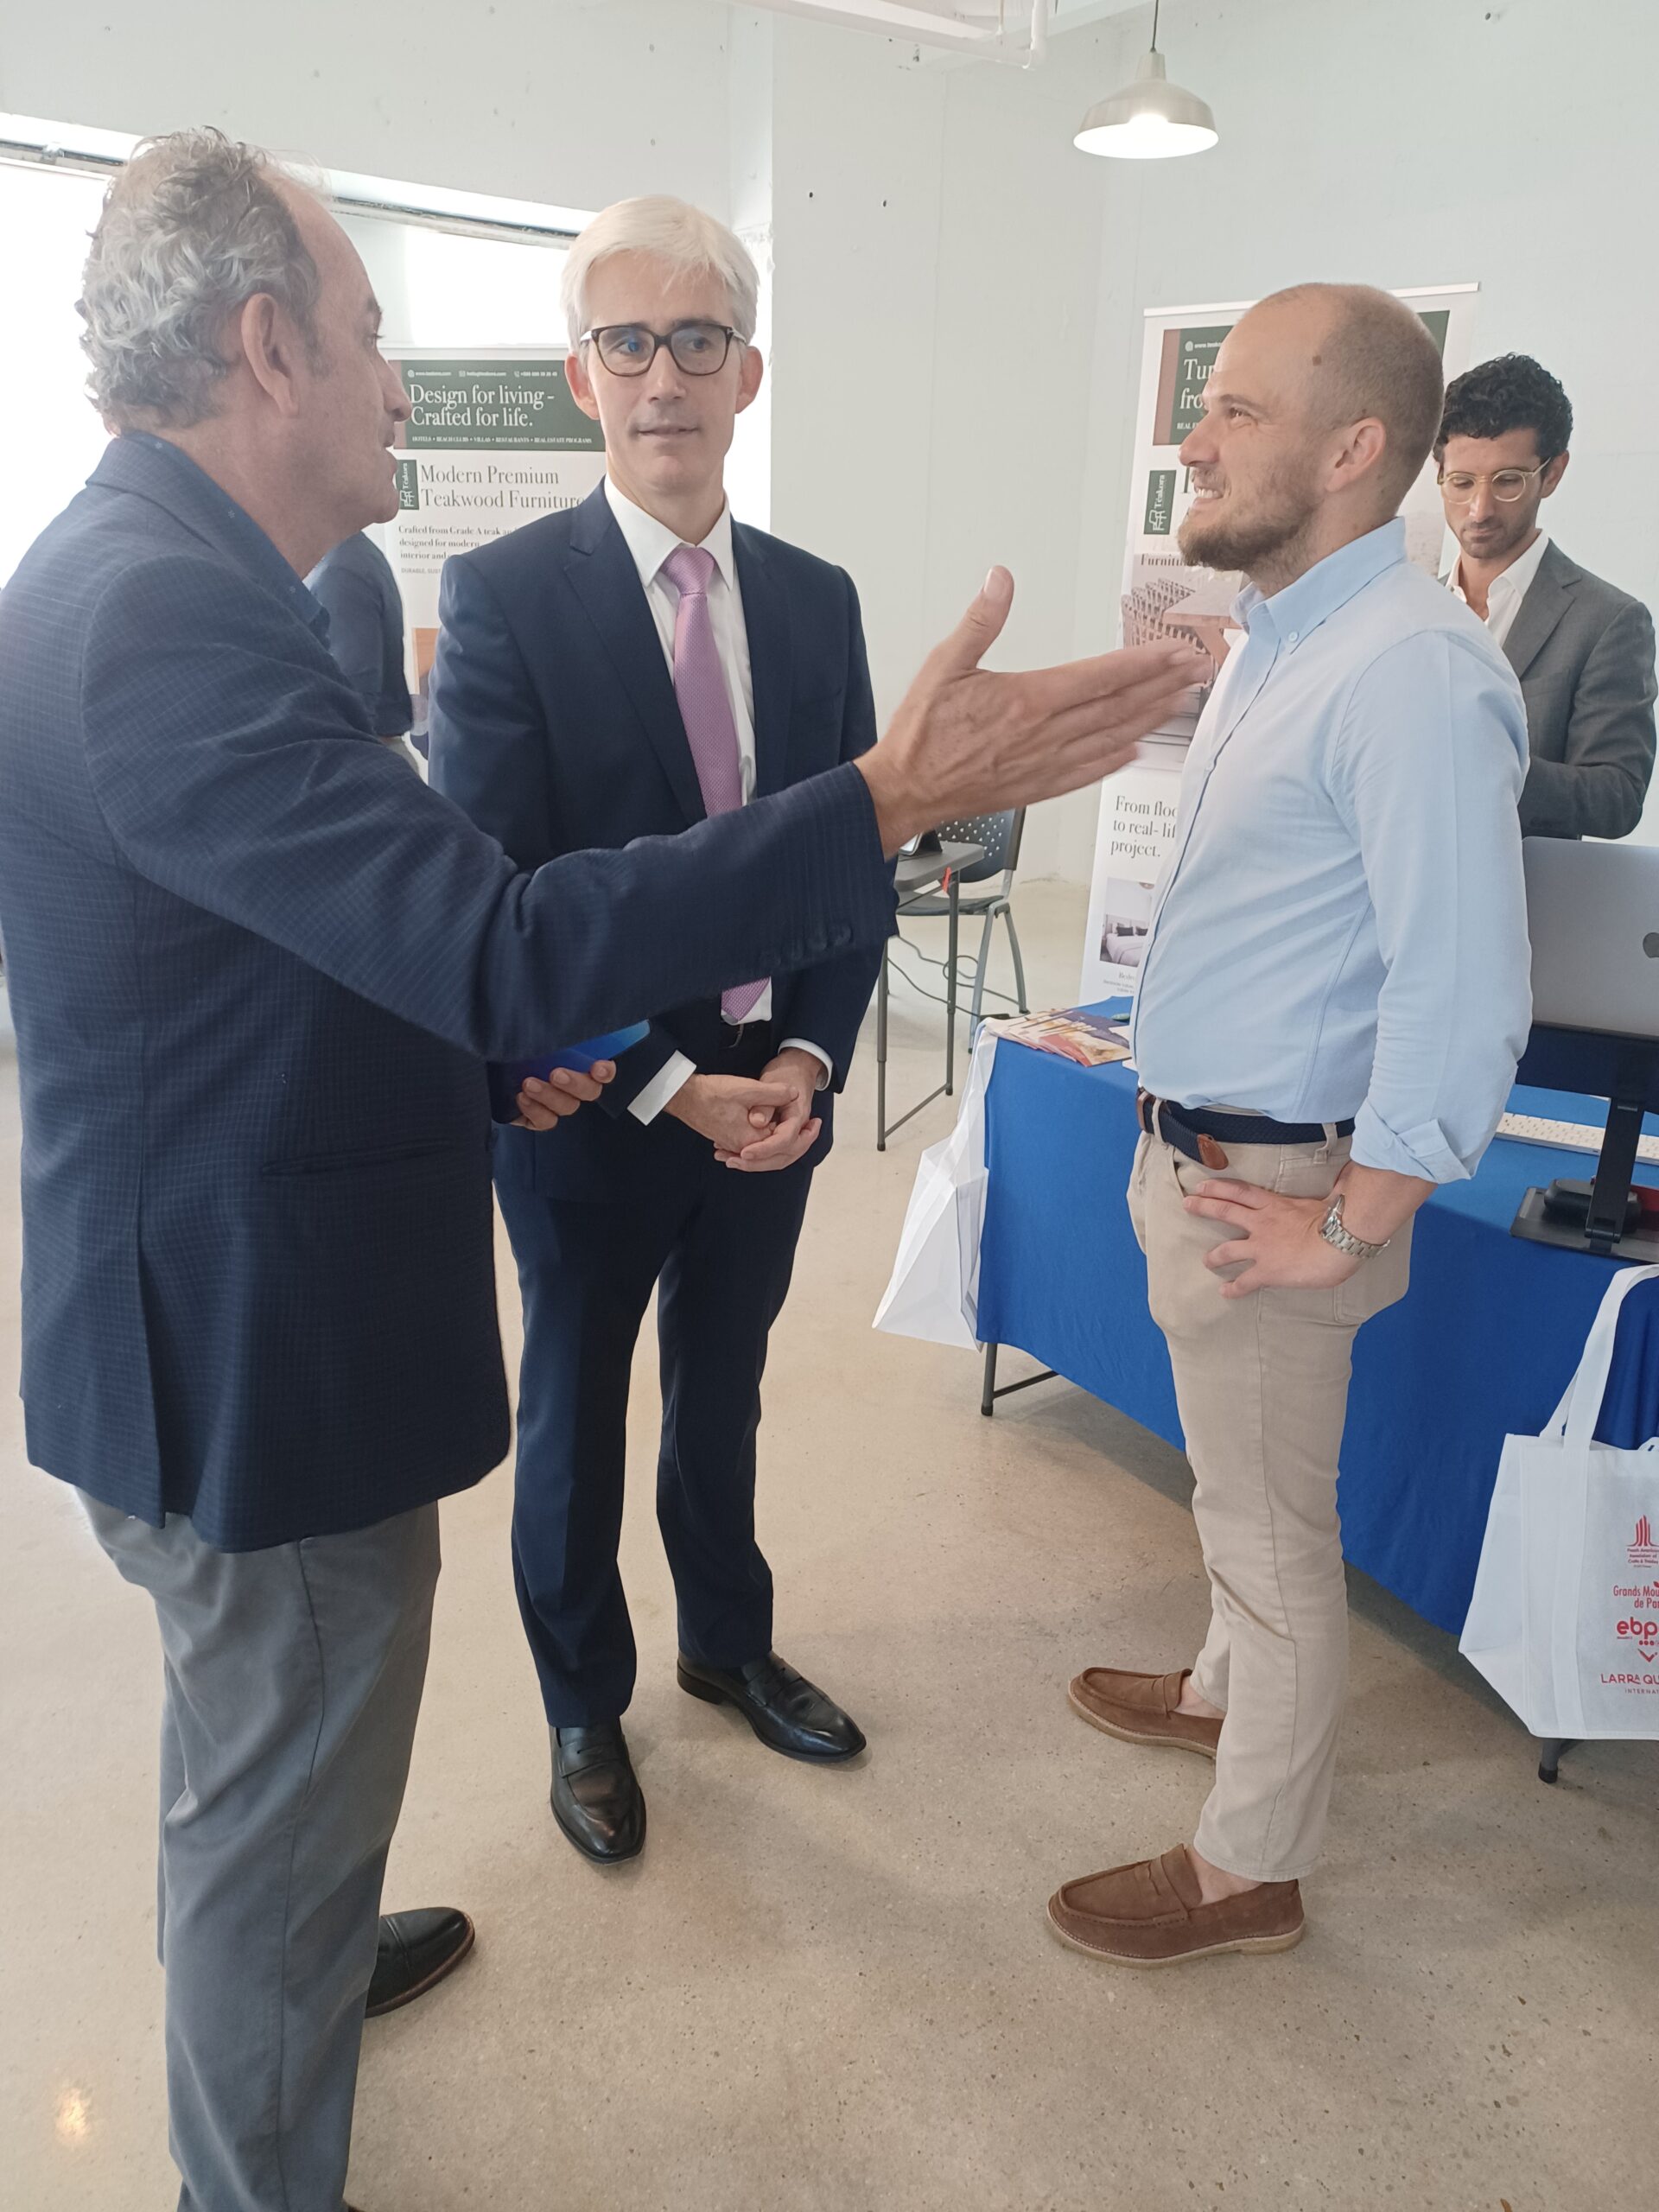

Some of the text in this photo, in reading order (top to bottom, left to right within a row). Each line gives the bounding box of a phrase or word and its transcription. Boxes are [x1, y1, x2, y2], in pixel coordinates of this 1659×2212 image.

[410, 384, 467, 410] Design
[472, 385, 495, 404] for
[499, 385, 544, 410] living
[410, 406, 533, 427] Crafted for life.
[421, 465, 559, 484] Modern Premium
[421, 488, 504, 508] Teakwood
[398, 525, 427, 534] Crafted
[429, 525, 448, 534] from
[449, 526, 473, 535] Grade
[484, 527, 500, 536] teak
[399, 538, 433, 547] designed
[435, 538, 446, 547] for
[1116, 795, 1150, 815] From
[1114, 820, 1126, 831] to
[1111, 839, 1160, 859] project.
[1613, 1585, 1641, 1597] Grands
[1634, 1598, 1644, 1608] de
